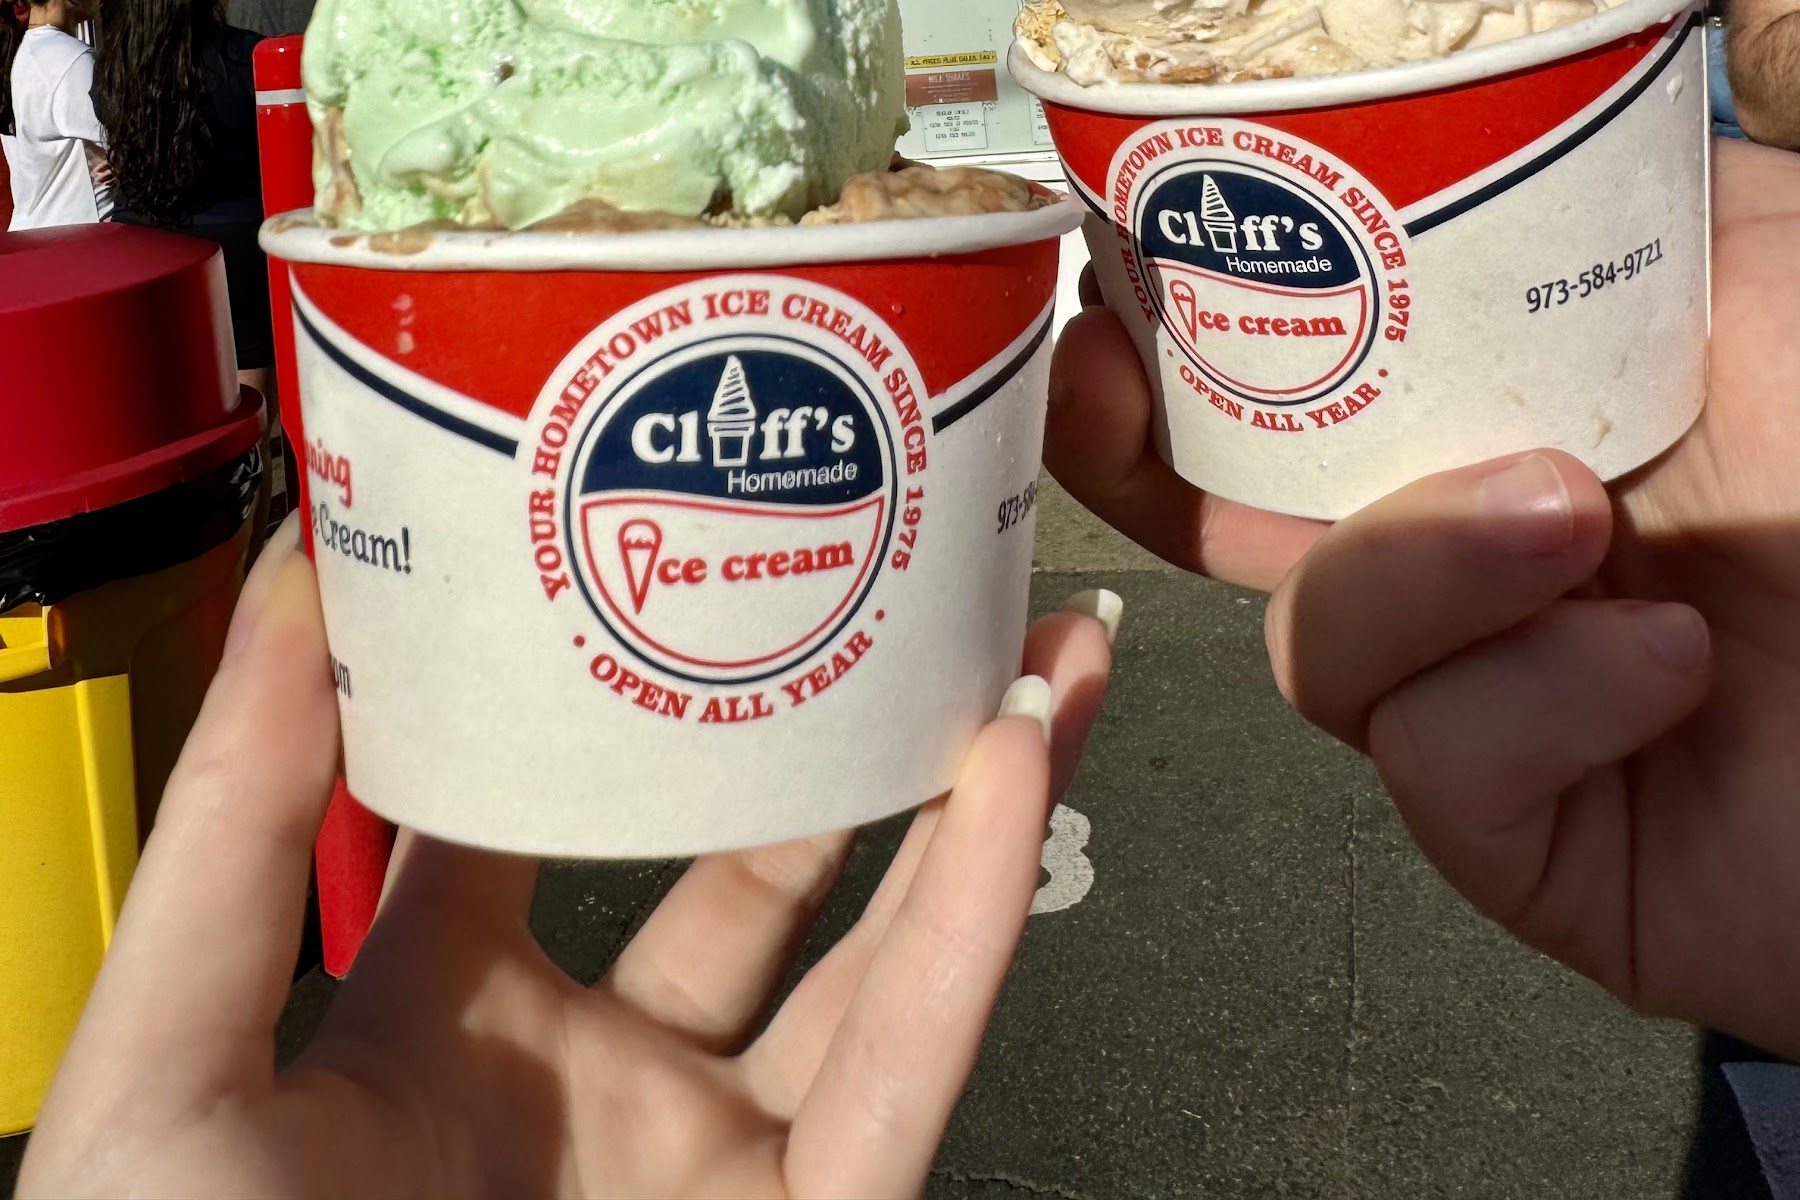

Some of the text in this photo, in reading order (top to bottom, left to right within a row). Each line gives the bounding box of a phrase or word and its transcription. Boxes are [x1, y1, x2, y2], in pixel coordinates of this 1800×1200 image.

[1112, 132, 1175, 242] HOMETOWN
[1175, 127, 1224, 148] ICE
[1233, 131, 1344, 190] CREAM
[1339, 187, 1407, 270] SINCE
[1384, 278, 1411, 343] 1975
[1225, 256, 1333, 274] Homemade
[1526, 237, 1663, 313] 973-584-9721
[1238, 314, 1347, 337] cream
[1179, 365, 1381, 432] OPEN ALL YEAR
[528, 289, 927, 602] YOUR HOMETOWN ICE CREAM SINCE 1975
[728, 459, 859, 494] Homemade
[320, 501, 412, 575] Cream!
[721, 541, 854, 582] cream
[590, 629, 874, 724] OPEN ALL YEAR
